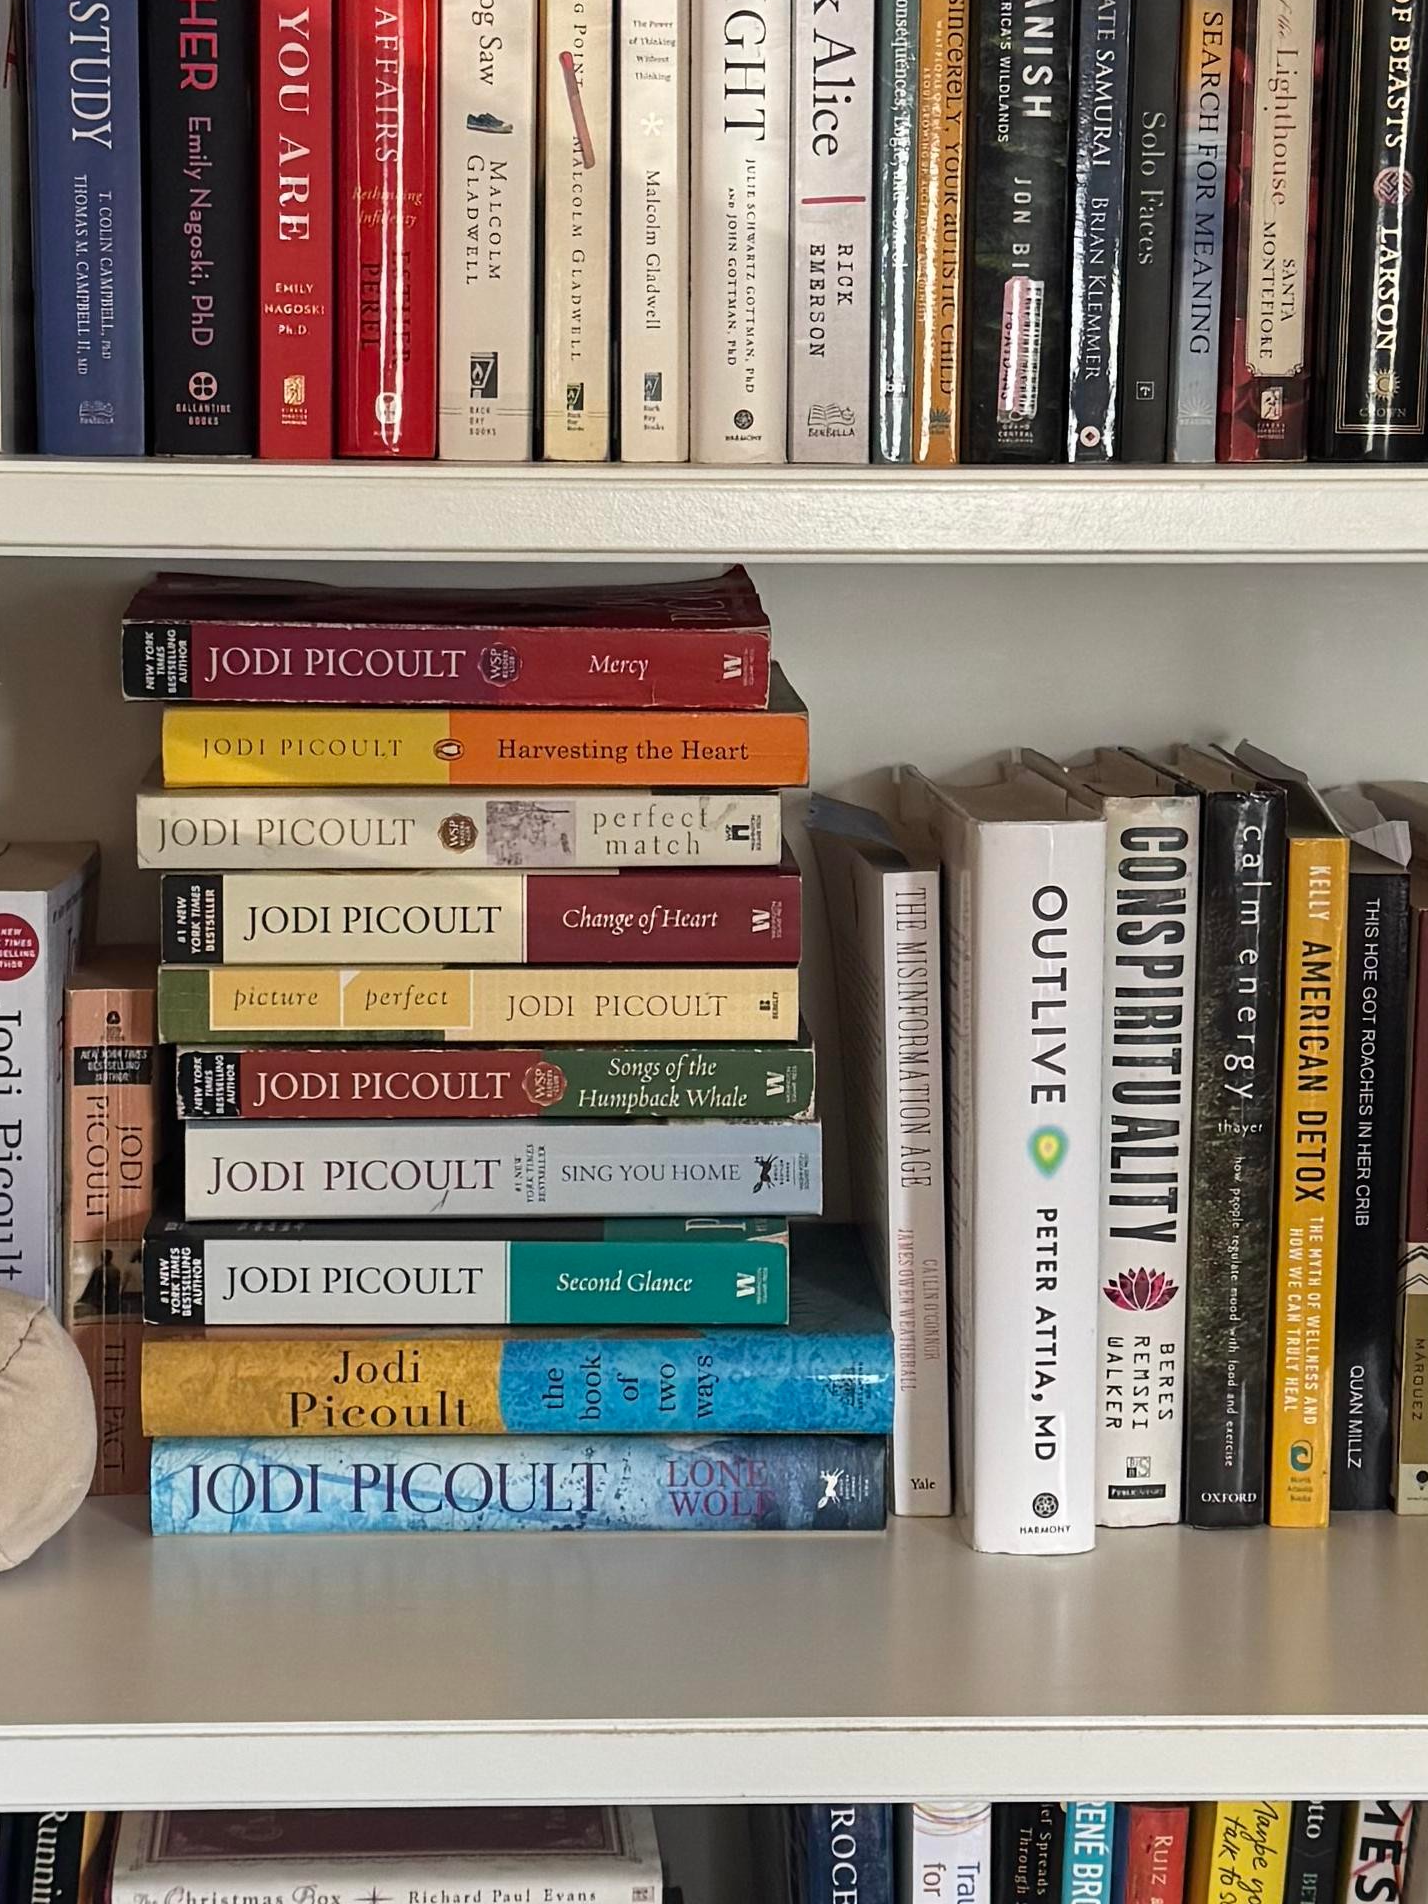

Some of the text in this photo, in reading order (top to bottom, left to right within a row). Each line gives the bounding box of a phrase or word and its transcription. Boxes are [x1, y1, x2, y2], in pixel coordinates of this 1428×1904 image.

[811, 17, 858, 157] Alice
[1142, 112, 1167, 174] Solo
[1137, 186, 1164, 265] Faces
[275, 283, 313, 293] EMILY
[837, 244, 854, 307] RICK
[265, 304, 325, 314] NAGOSKI
[809, 244, 826, 359] EMERSON
[277, 324, 310, 335] Ph.D.
[206, 648, 648, 681] JODI PICOULT Mercy
[497, 738, 749, 763] Harvesting the Heart
[592, 804, 709, 835] perfect
[604, 829, 701, 856] match
[233, 984, 449, 1011] picture perfect
[1030, 884, 1069, 1105] OUTLIVE
[1107, 825, 1188, 1247] CONSPIRITUALITY
[1218, 1119, 1263, 1135] thayer
[556, 1270, 692, 1294] Second Glance
[1033, 1208, 1058, 1461] PETER ATTIA, MD
[540, 1368, 566, 1410] the
[578, 1354, 603, 1421] book
[619, 1375, 639, 1402] of
[656, 1362, 677, 1412] two
[696, 1354, 717, 1419] ways
[1106, 1337, 1122, 1429] WALKER
[1133, 1337, 1149, 1430] REMSKI
[1159, 1343, 1175, 1420] BERES
[910, 1477, 936, 1491] Yale
[1201, 1492, 1258, 1504] OXFORD
[1019, 1525, 1071, 1536] HARMONY
